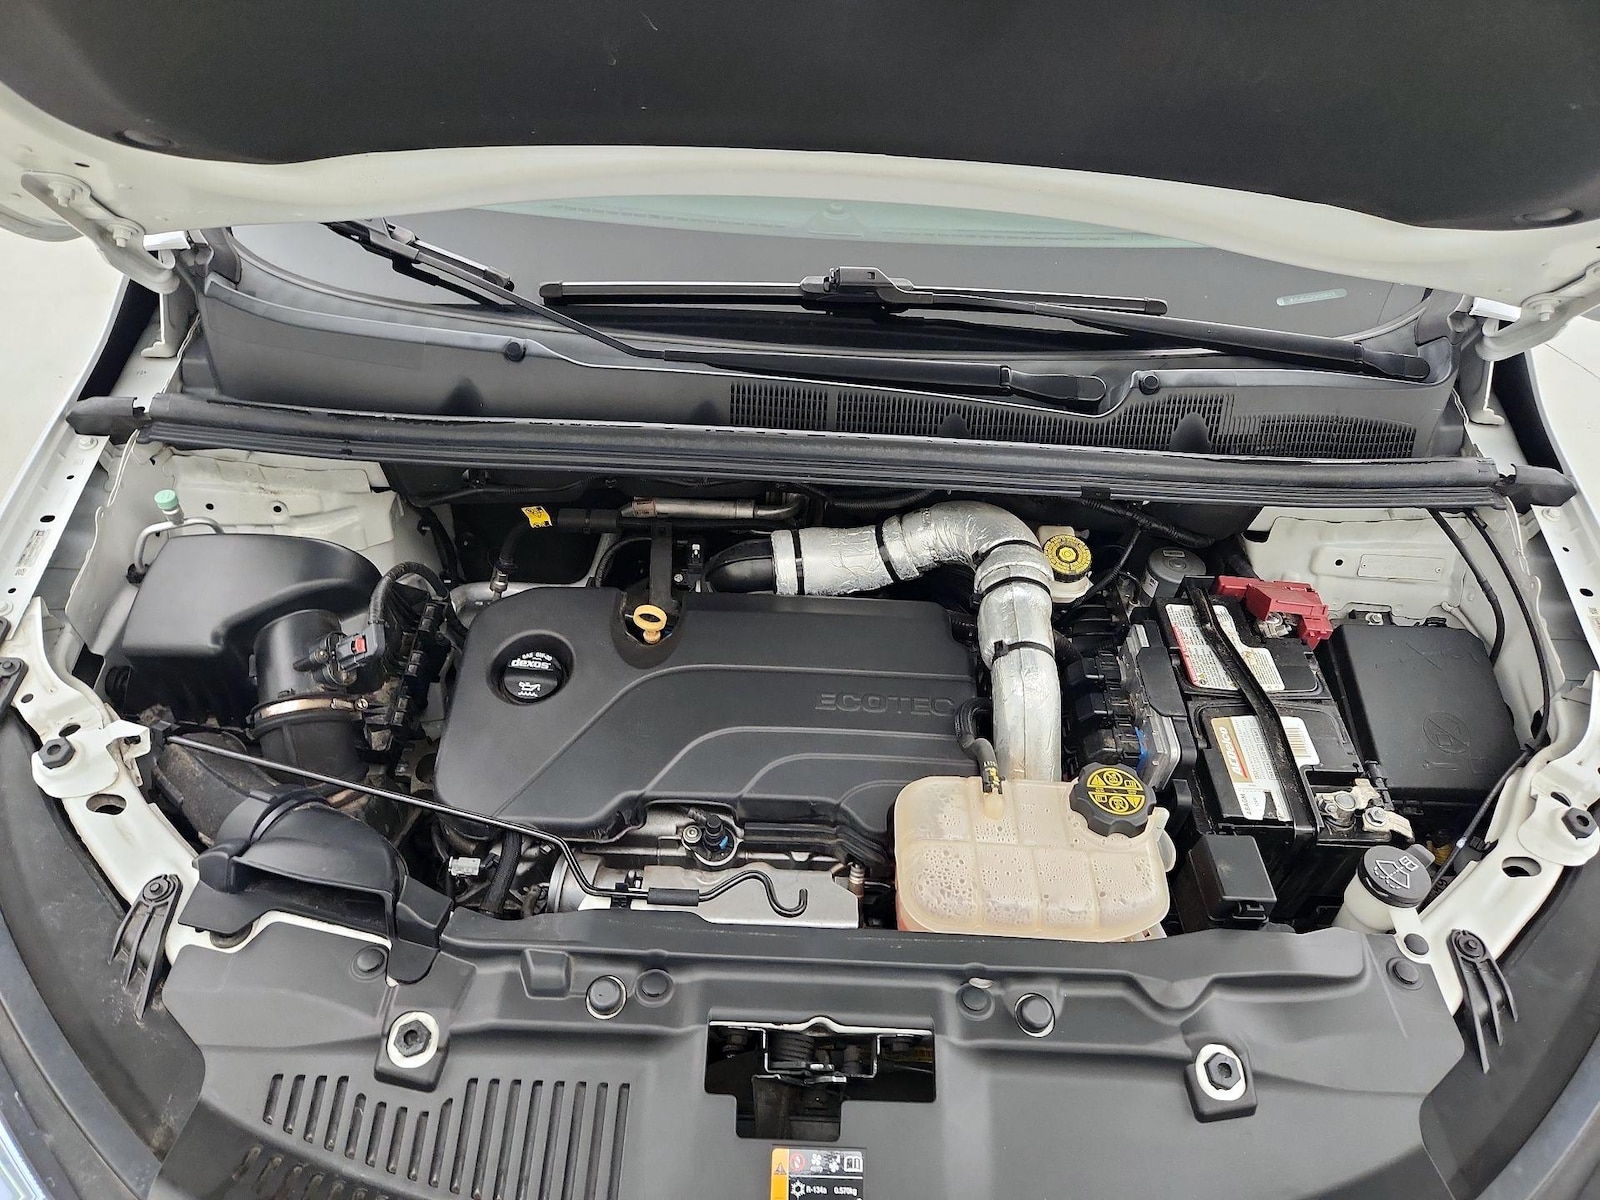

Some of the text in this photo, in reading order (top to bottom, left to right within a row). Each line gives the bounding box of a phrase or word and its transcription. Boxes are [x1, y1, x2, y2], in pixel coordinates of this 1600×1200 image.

[814, 691, 955, 717] ECOTEC
[1219, 726, 1245, 777] ACDelco
[806, 1185, 858, 1197] R-134a 0.570kg
